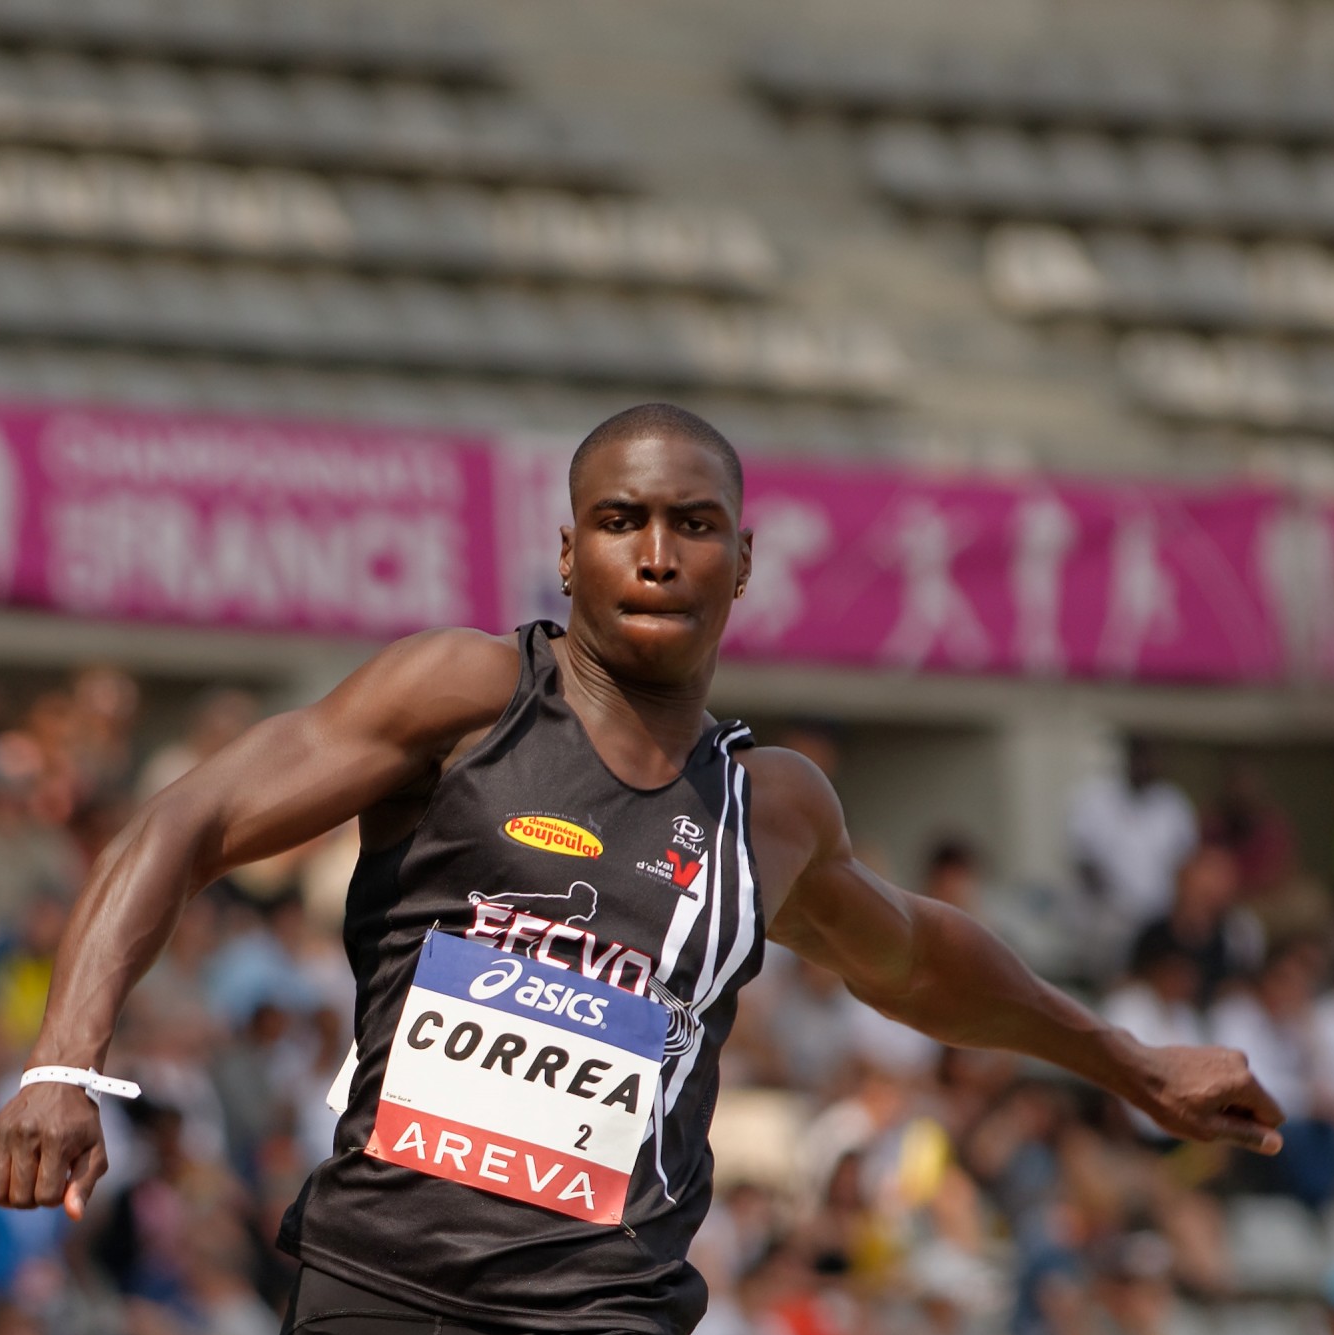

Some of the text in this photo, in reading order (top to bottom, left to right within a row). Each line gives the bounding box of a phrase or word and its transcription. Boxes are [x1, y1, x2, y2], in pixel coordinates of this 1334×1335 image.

[509, 817, 600, 859] Poujoulat
[528, 816, 578, 838] cheminées
[407, 1010, 642, 1115] CORREA
[573, 1123, 593, 1151] 2
[392, 1121, 597, 1210] AREVA
